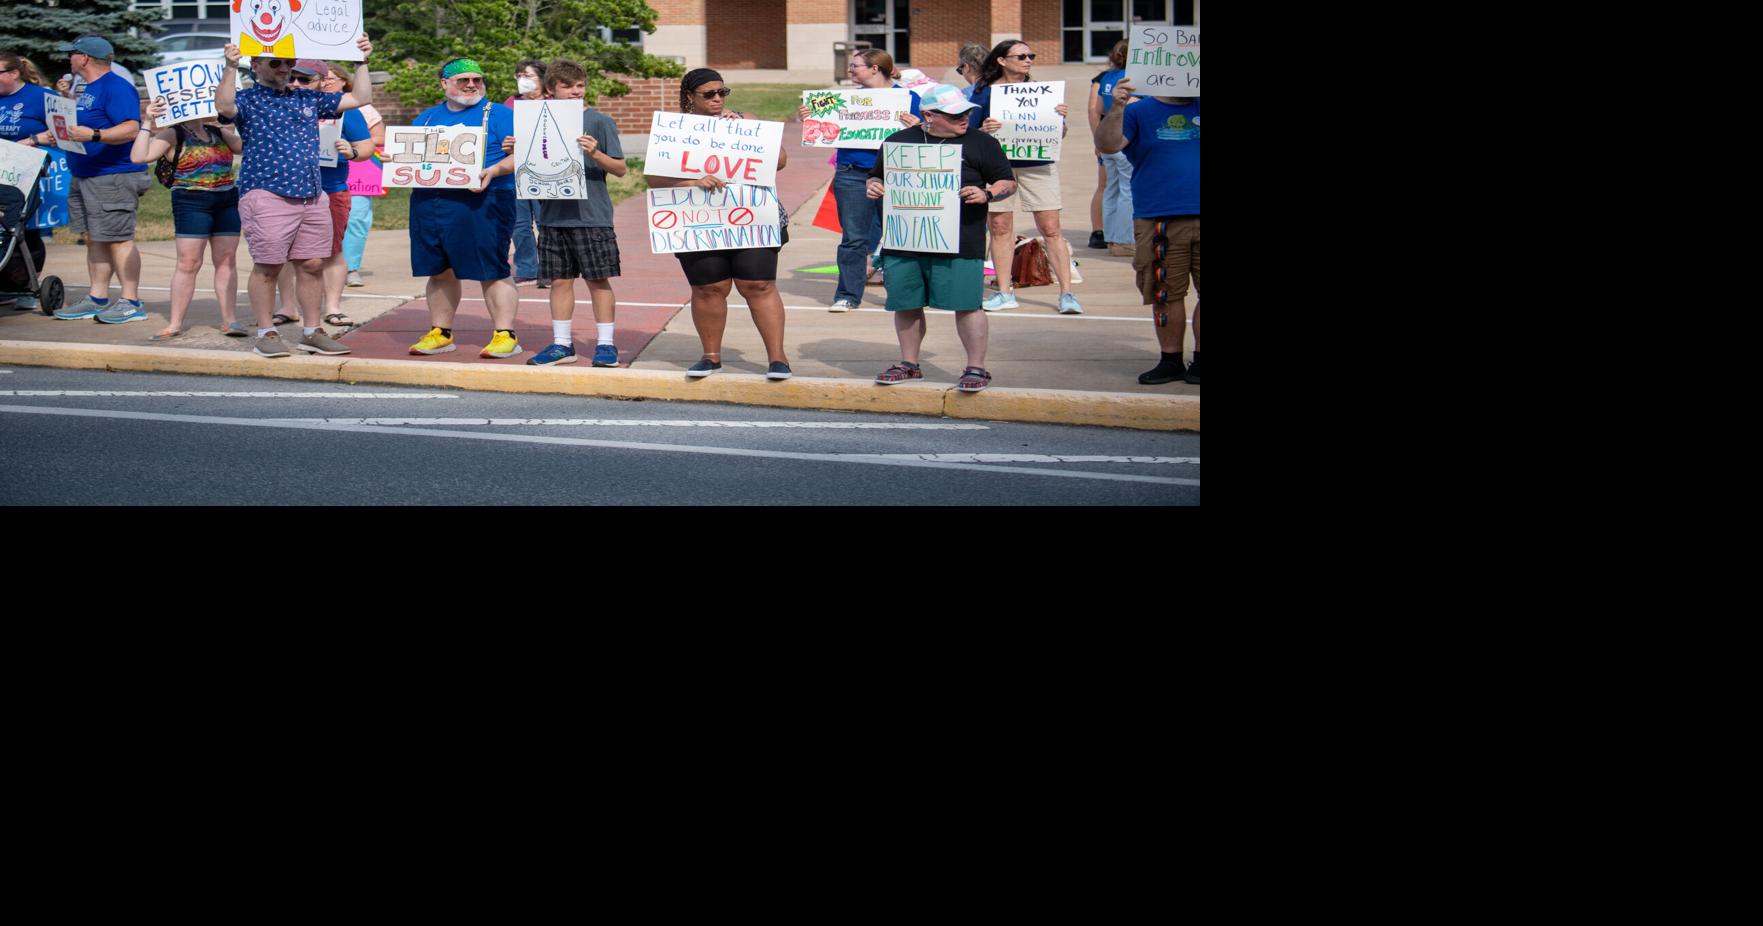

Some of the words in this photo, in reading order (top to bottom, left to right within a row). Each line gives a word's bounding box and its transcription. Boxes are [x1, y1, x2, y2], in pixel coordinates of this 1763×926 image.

[316, 3, 350, 22] Legal
[307, 18, 349, 33] advice
[1176, 30, 1200, 45] BA
[1130, 47, 1200, 67] Introv
[155, 64, 225, 94] E-TOW
[1146, 74, 1177, 87] are
[1000, 85, 1054, 95] THANK
[171, 100, 215, 119] BETT
[1015, 97, 1039, 107] YOU
[657, 114, 684, 130] Let
[693, 119, 716, 134] all
[726, 121, 761, 138] that
[1015, 123, 1058, 133] MANOR
[653, 133, 677, 145] you
[682, 135, 701, 146] do
[710, 137, 726, 149] be
[730, 141, 766, 154] done
[1002, 143, 1051, 159] HOPE
[885, 143, 957, 169] KEEP
[658, 150, 671, 160] in
[680, 151, 764, 182] LOVE
[391, 166, 472, 187] SUS
[885, 171, 913, 188] OUR
[916, 172, 962, 192] SCHOOLS
[650, 185, 779, 208] EDUCATION
[890, 189, 945, 206] INCLUSIVE
[682, 208, 728, 224] NOT
[651, 224, 782, 252] DISCRIMINATION
[883, 214, 908, 248] AND
[912, 215, 950, 250] FAIR
